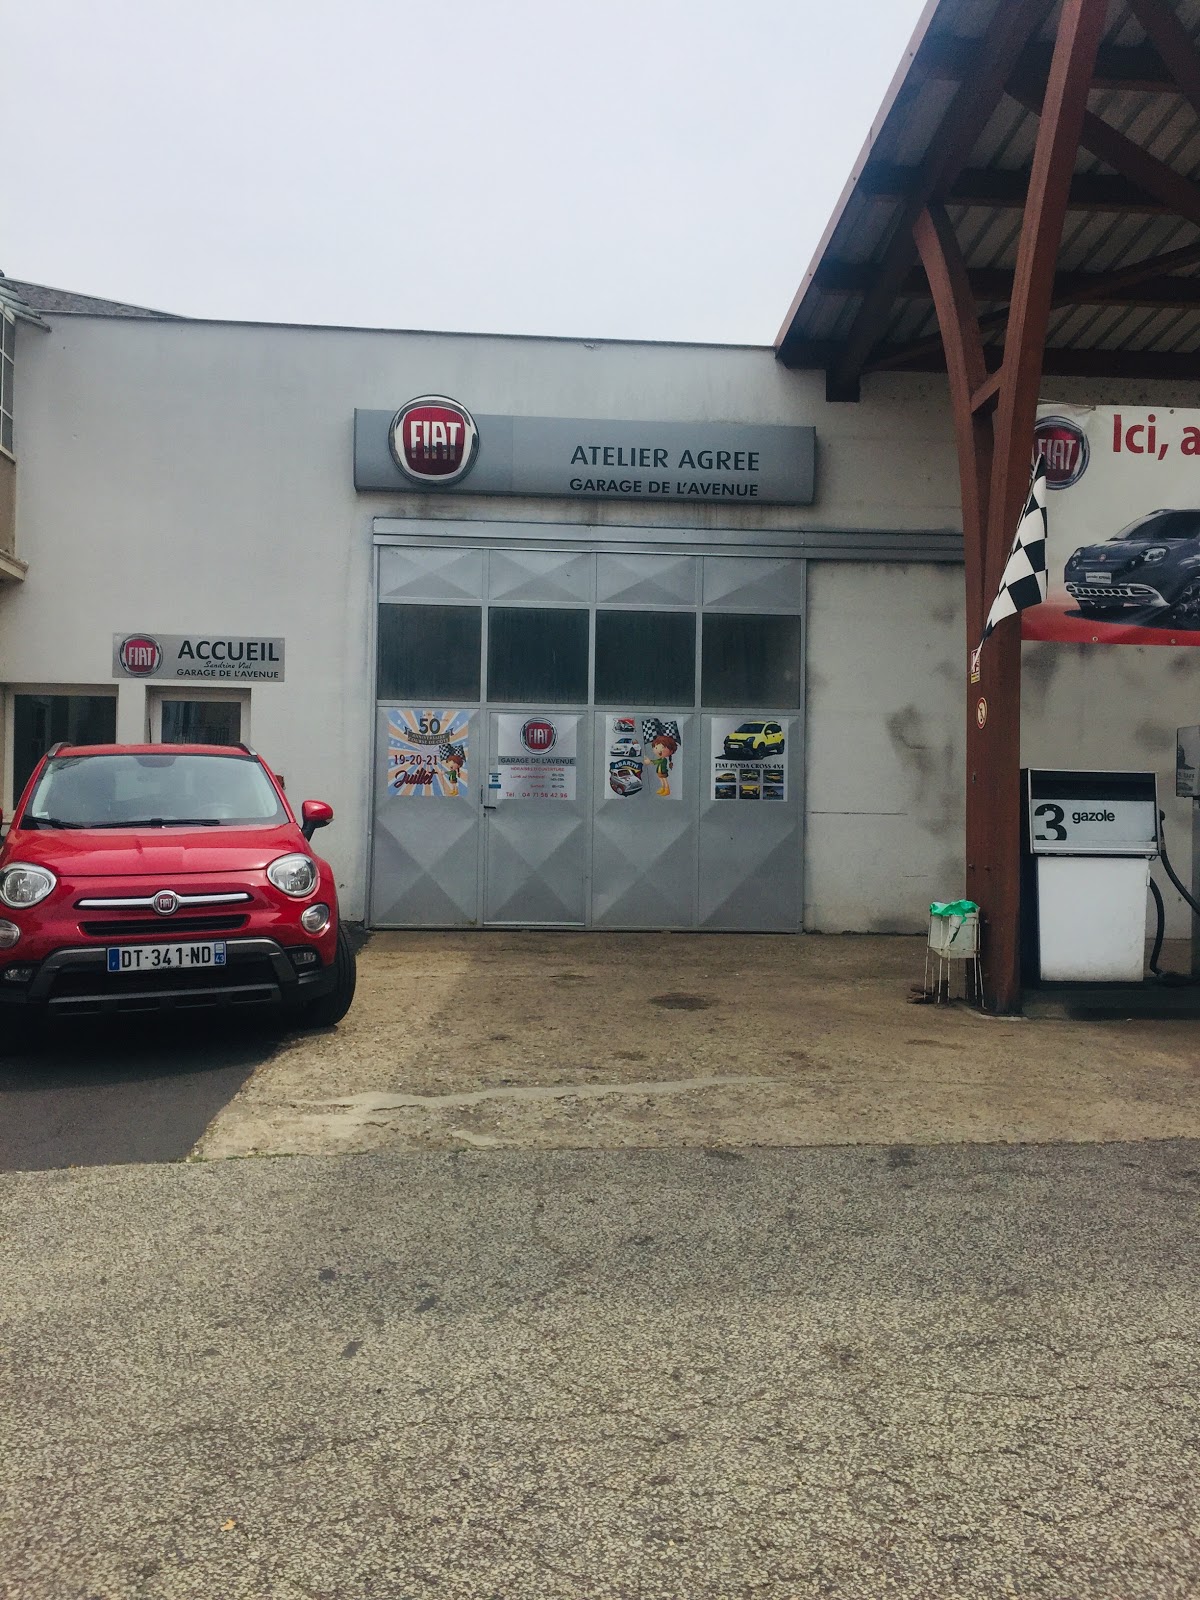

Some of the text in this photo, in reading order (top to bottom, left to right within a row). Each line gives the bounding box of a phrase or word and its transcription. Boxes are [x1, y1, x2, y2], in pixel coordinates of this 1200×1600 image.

[410, 420, 461, 452] FIAT
[1113, 414, 1169, 461] Ici,
[570, 445, 760, 471] ATELIER AGREE
[1038, 438, 1076, 470] FIAT
[569, 478, 759, 496] GARAGE DE L'AVENUE
[128, 647, 153, 666] FIAT
[177, 640, 279, 661] ACCUEIL
[176, 668, 279, 679] GARAGE DE L'AVENUE
[203, 660, 236, 669] Sandrine
[419, 718, 441, 734] 50
[528, 728, 550, 745] FIAT
[394, 754, 437, 766] 19-20-21
[394, 768, 438, 788] Juillet
[1034, 803, 1115, 840] 3 gazole
[160, 898, 172, 908] FIAT
[122, 946, 211, 968] DT-341-ND
[215, 953, 224, 963] 43
